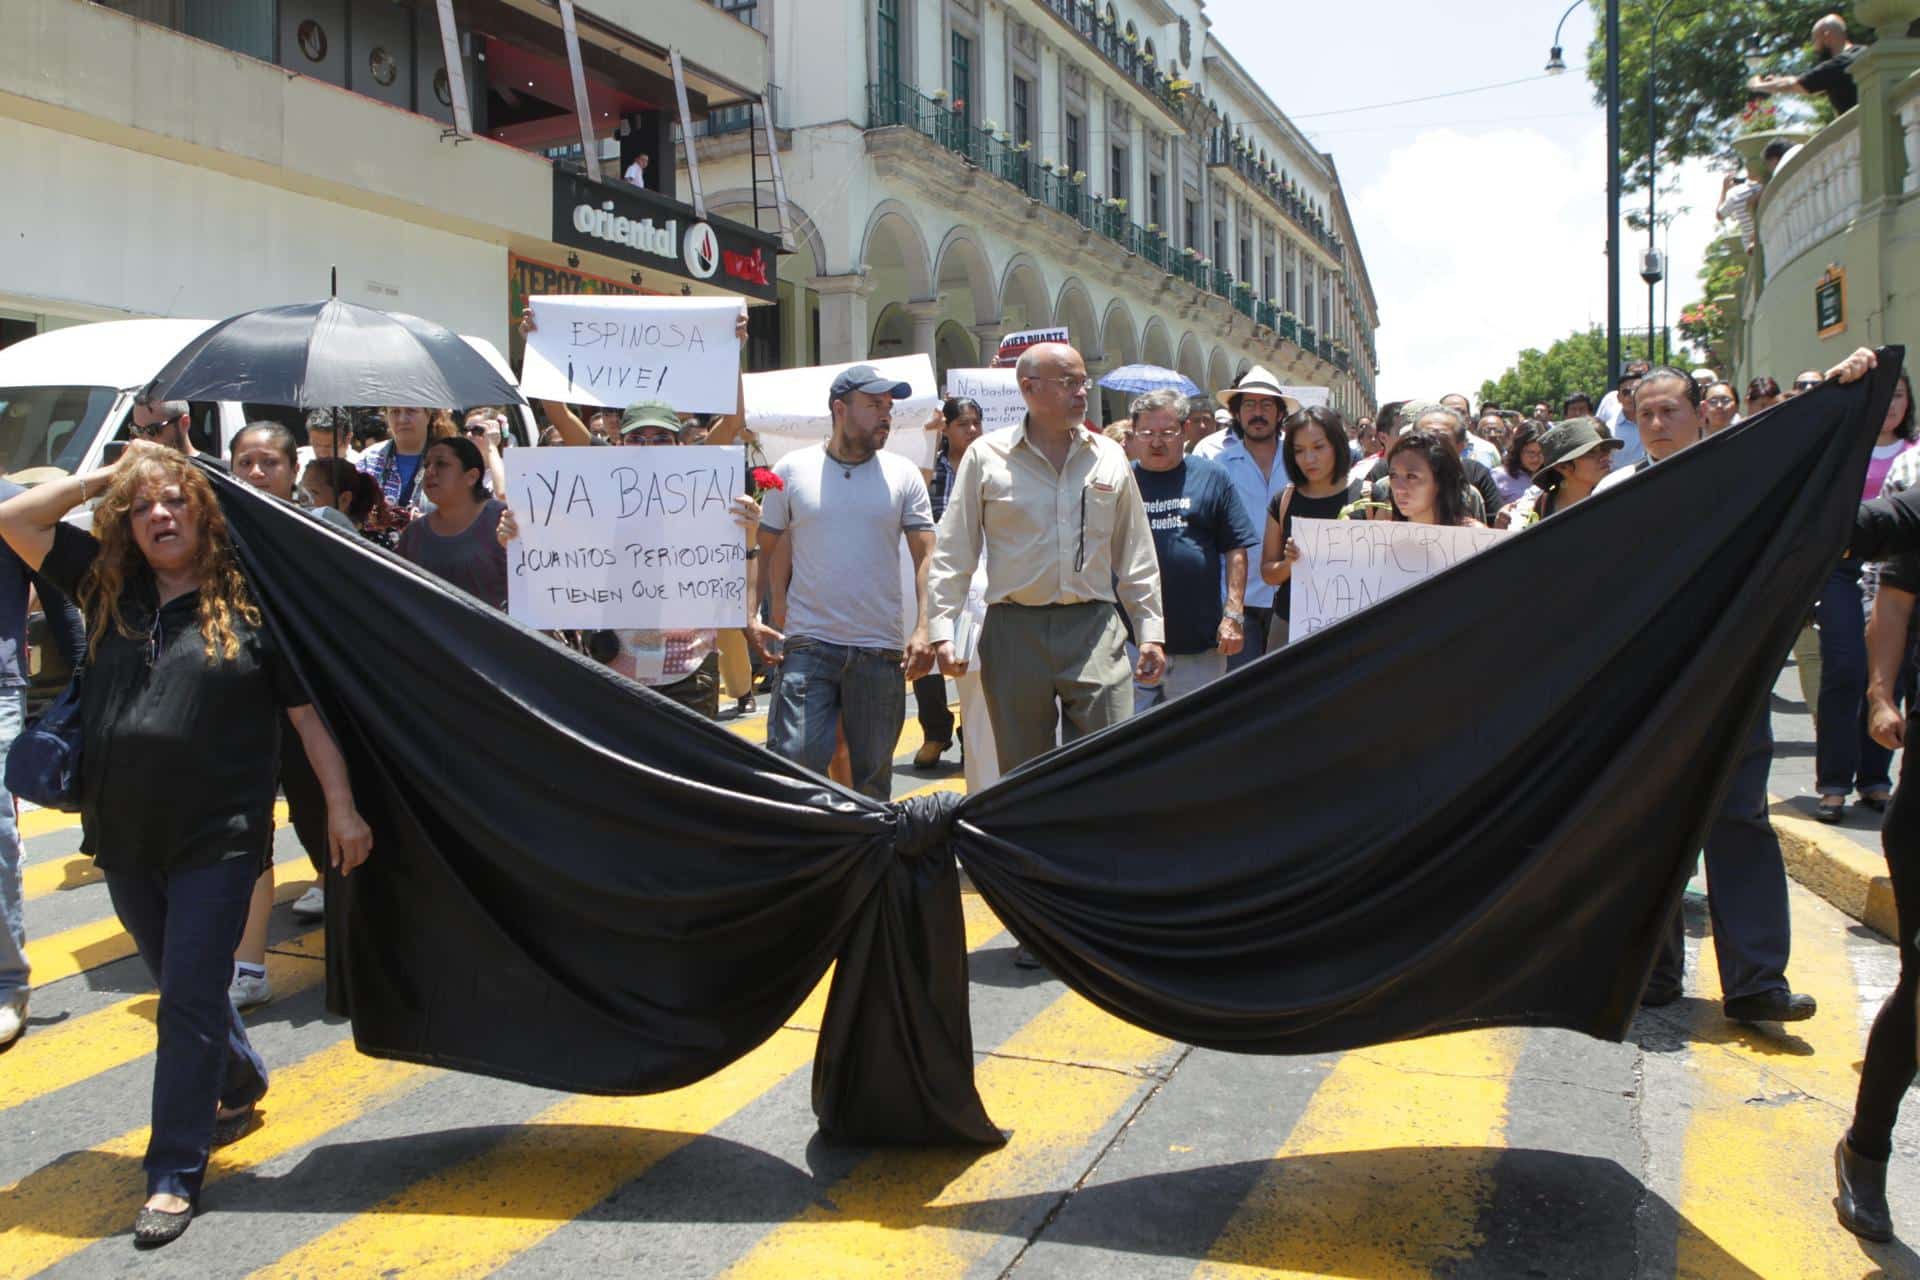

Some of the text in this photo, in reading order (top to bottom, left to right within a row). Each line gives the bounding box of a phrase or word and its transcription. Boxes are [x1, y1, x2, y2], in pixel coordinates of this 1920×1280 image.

[572, 200, 678, 260] oriental
[568, 321, 705, 353] ESPINOSA
[1027, 331, 1065, 344] DUARTE
[957, 376, 977, 397] No
[521, 469, 595, 527] ¡YA
[515, 546, 617, 577] ¿CUANTOS
[547, 586, 623, 604] TIENEN
[631, 580, 670, 600] QUE
